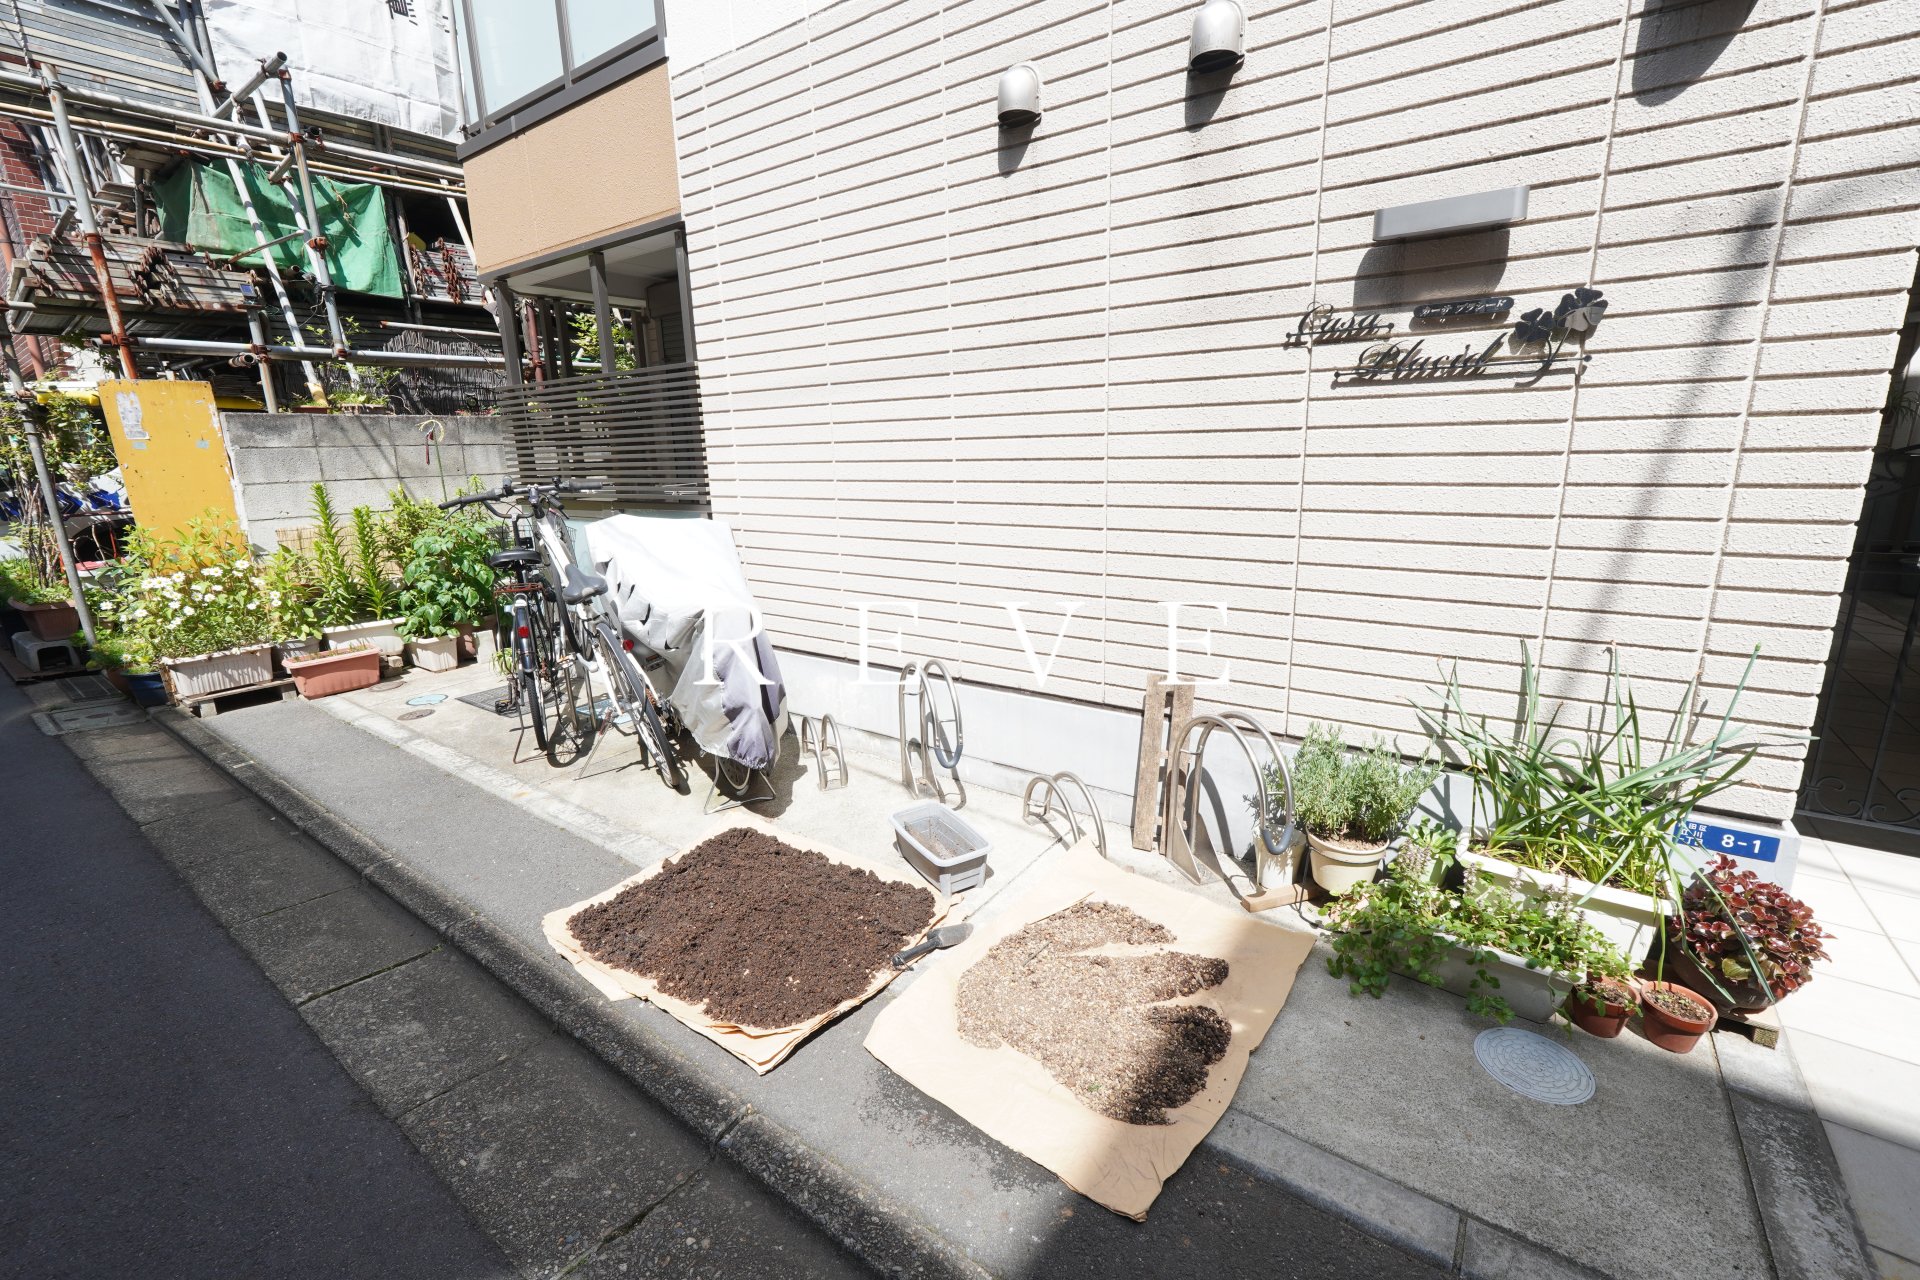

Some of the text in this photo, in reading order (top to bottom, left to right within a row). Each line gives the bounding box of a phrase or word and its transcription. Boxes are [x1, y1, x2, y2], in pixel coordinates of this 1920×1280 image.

[1297, 301, 1383, 335] Casa
[1354, 331, 1508, 377] Placid
[1678, 821, 1707, 833] 田区
[1721, 833, 1761, 854] 8-1
